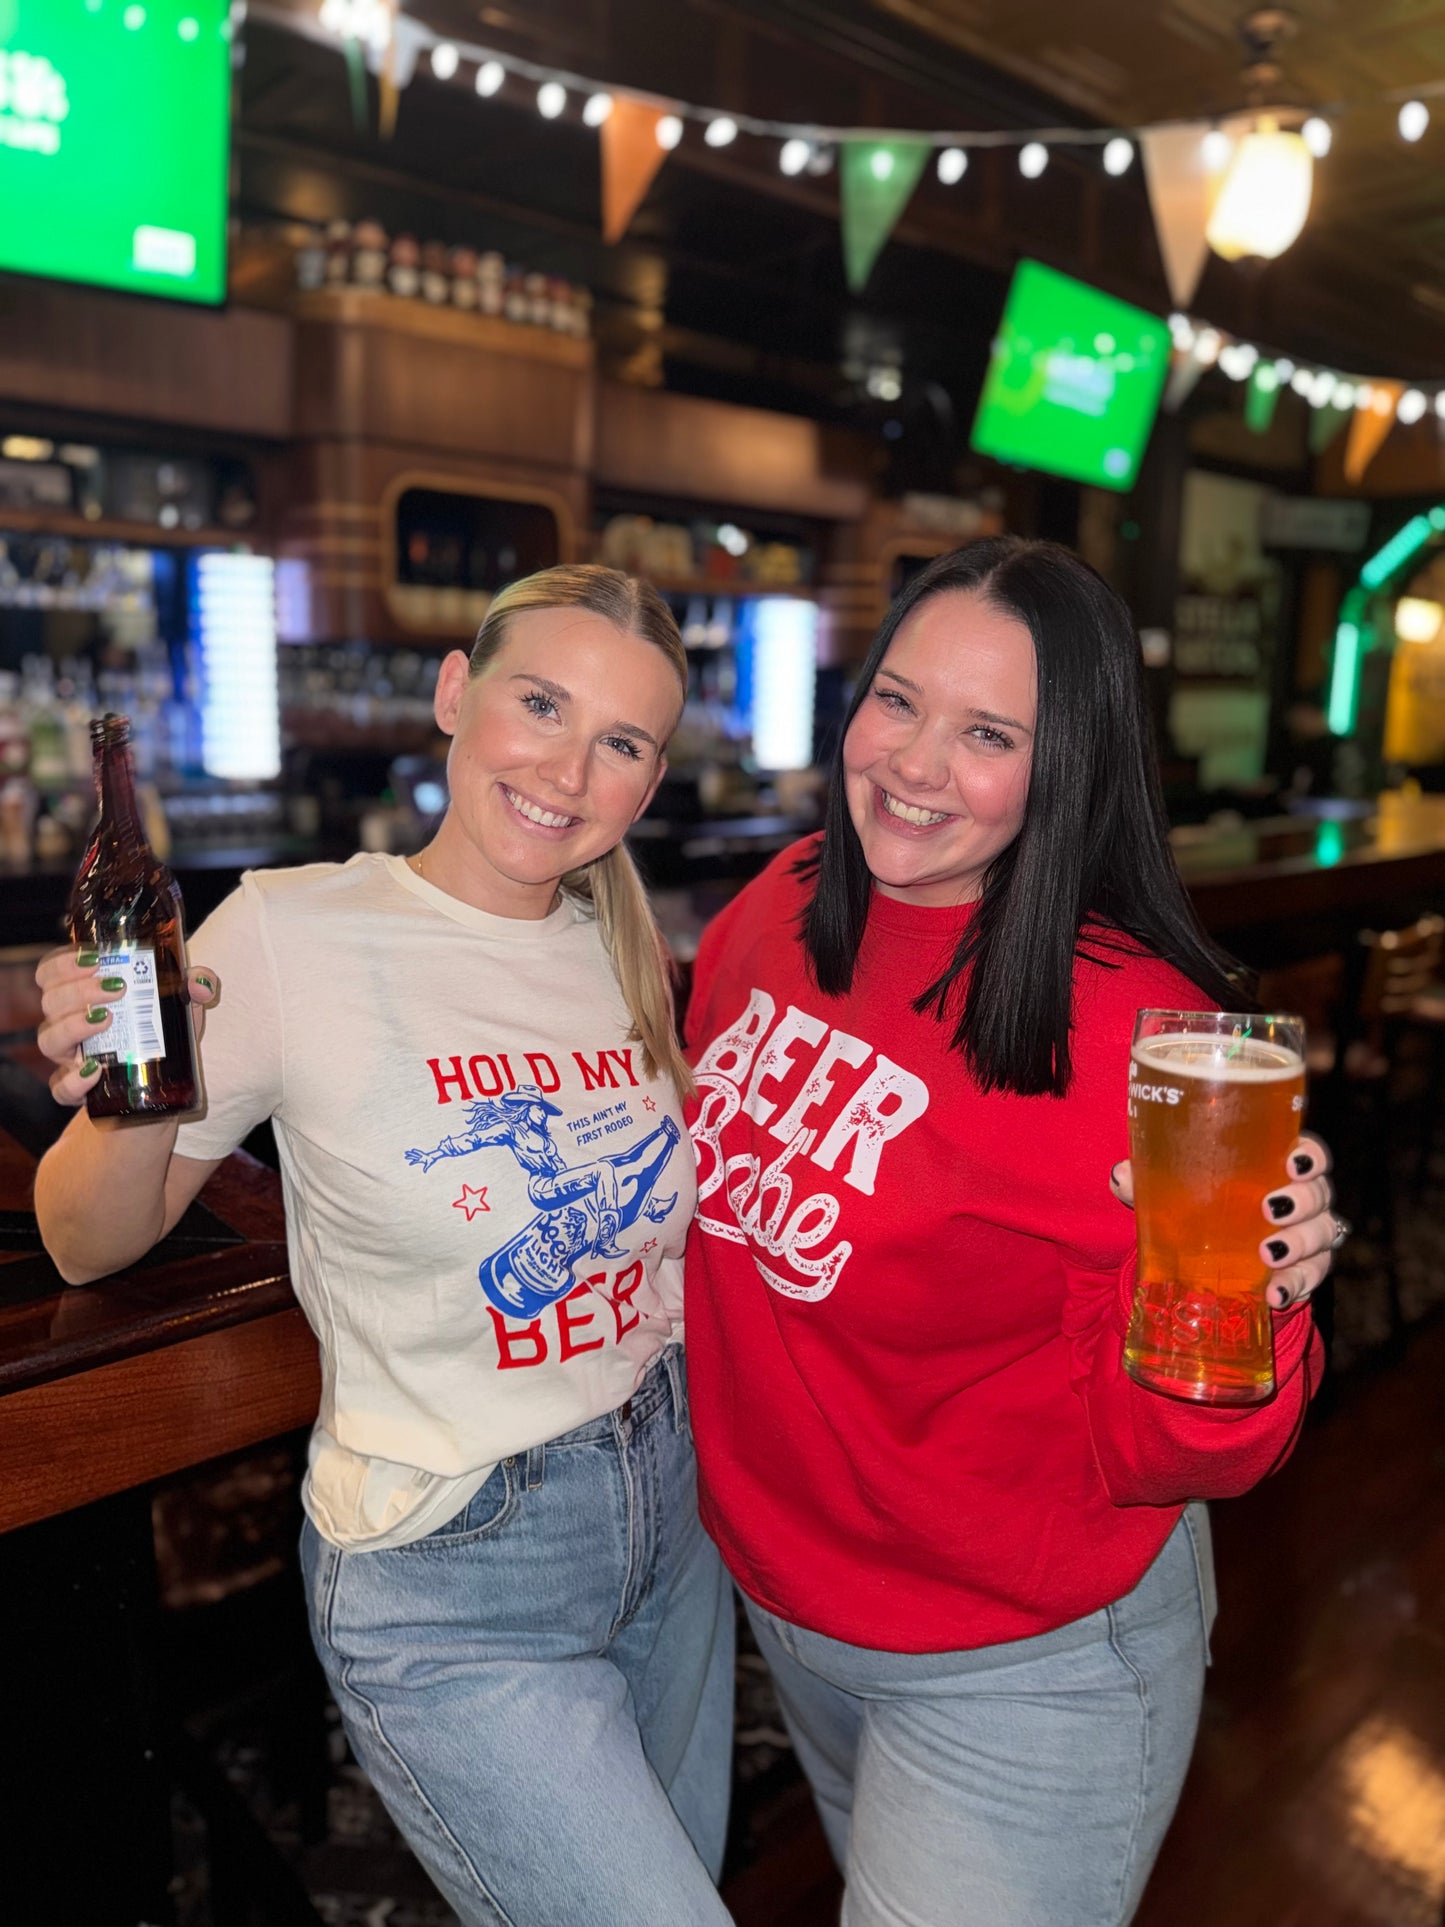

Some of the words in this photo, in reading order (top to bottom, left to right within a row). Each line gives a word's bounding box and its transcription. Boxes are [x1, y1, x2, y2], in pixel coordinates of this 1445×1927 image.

[426, 1052, 561, 1104] HOLD
[571, 1049, 640, 1091] MY
[692, 987, 930, 1196] BEER
[566, 1117, 591, 1133] THIS
[592, 1106, 614, 1123] AIN'T
[614, 1100, 627, 1114] MY
[576, 1127, 603, 1147] FIRST
[604, 1115, 634, 1134] RODEO
[690, 1073, 853, 1302] Babe
[530, 1238, 565, 1278] LIGHT
